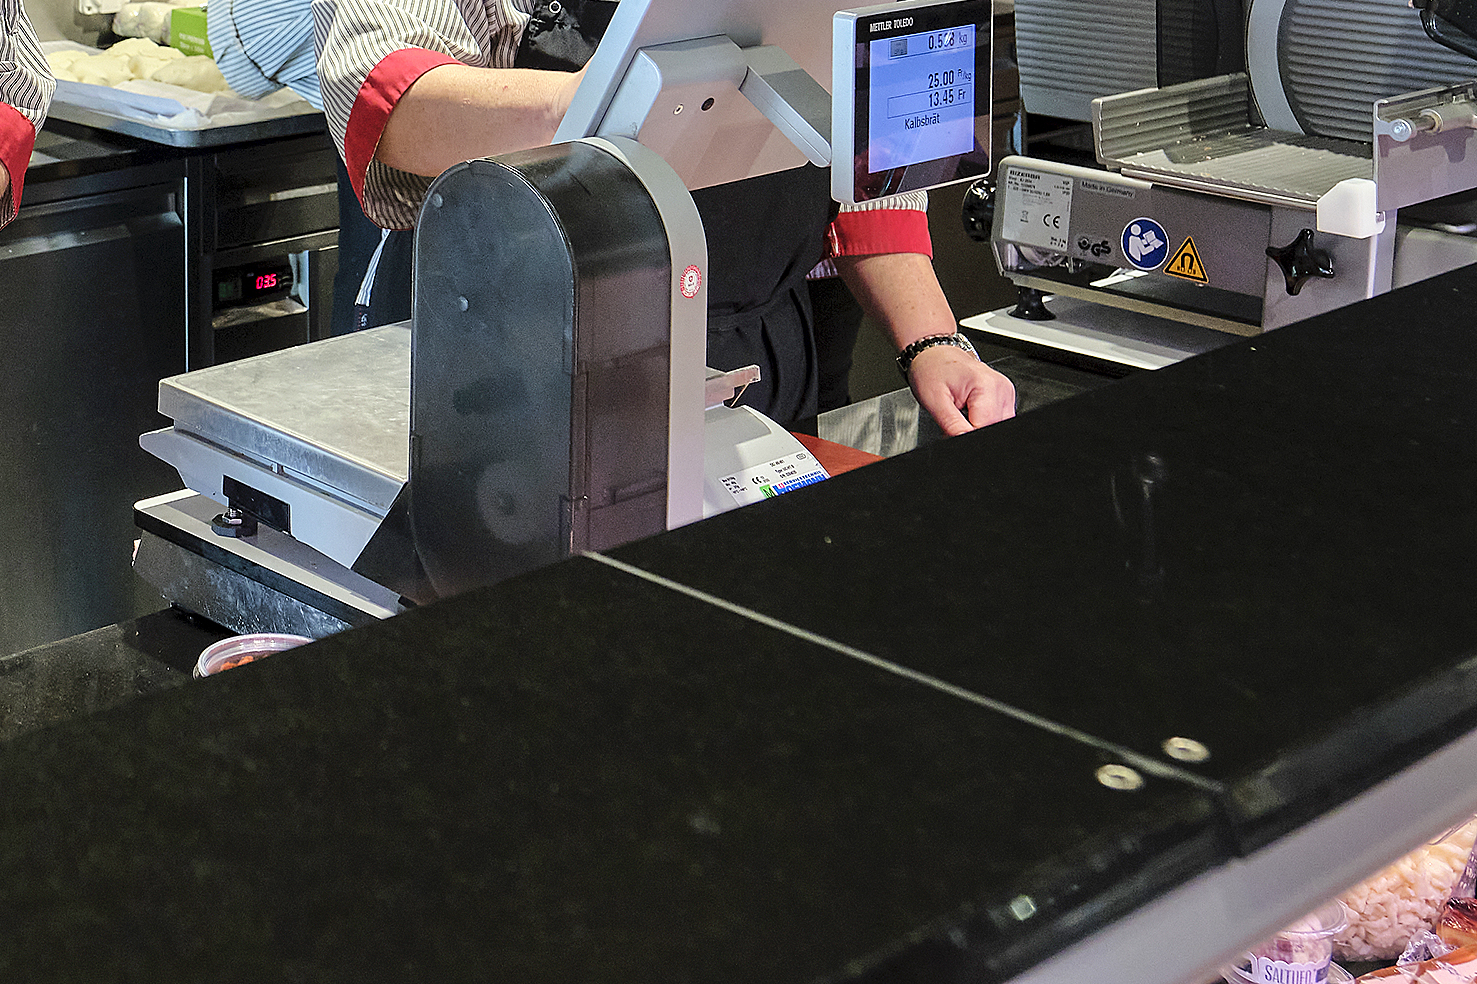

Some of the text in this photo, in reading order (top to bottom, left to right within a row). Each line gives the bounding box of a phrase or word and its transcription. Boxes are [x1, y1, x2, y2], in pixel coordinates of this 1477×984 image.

[869, 17, 914, 33] METTLER TOLEDO
[958, 31, 967, 45] kg
[928, 70, 954, 89] 25.00
[928, 89, 966, 108] 13.45 Fr
[904, 112, 941, 130] Kalbsbrät
[1043, 213, 1061, 229] CE
[1090, 240, 1112, 258] GS
